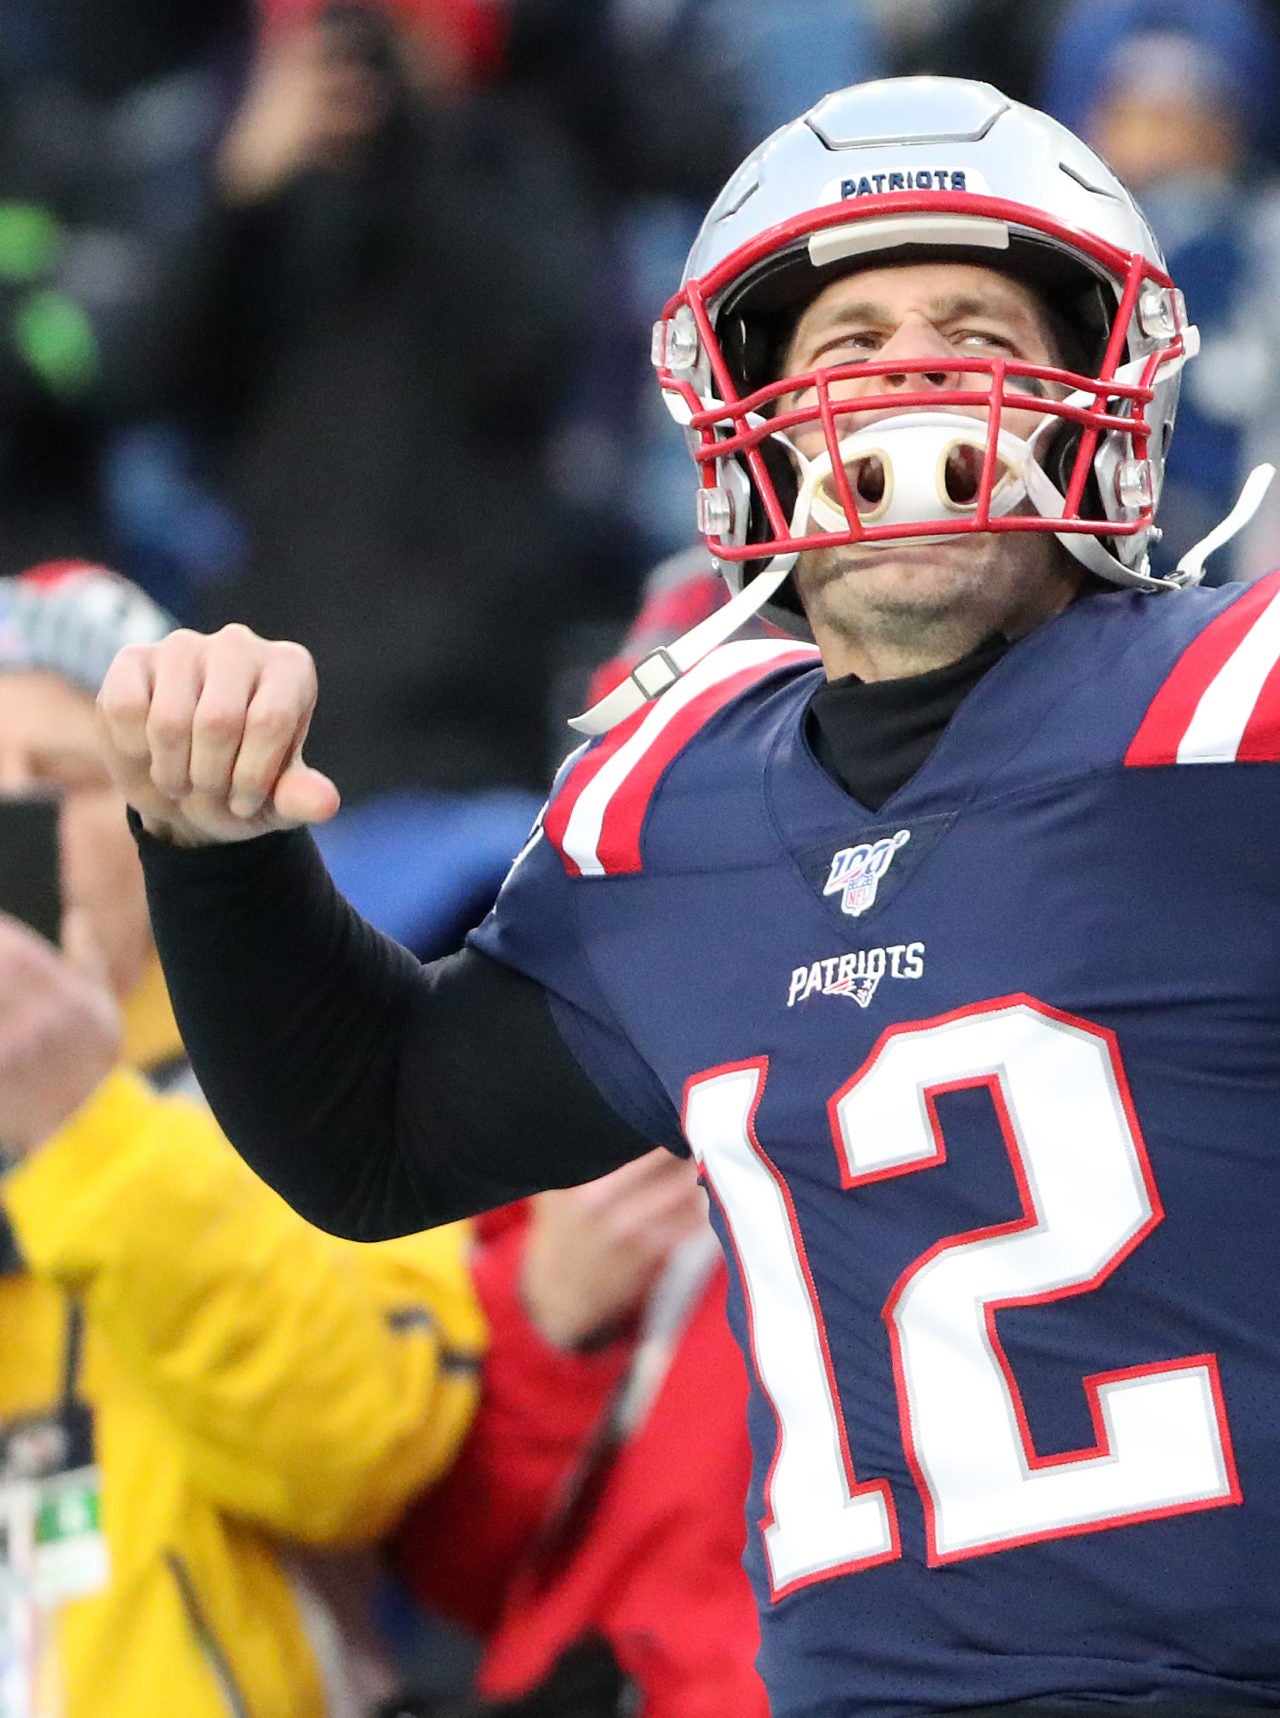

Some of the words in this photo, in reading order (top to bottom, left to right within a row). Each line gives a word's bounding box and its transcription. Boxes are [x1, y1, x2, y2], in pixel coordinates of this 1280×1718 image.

[840, 170, 967, 200] PATRIOTS
[832, 840, 892, 880] 100
[847, 887, 871, 906] NFL
[786, 941, 926, 1007] PATRIOTS
[681, 992, 1243, 1604] 12
